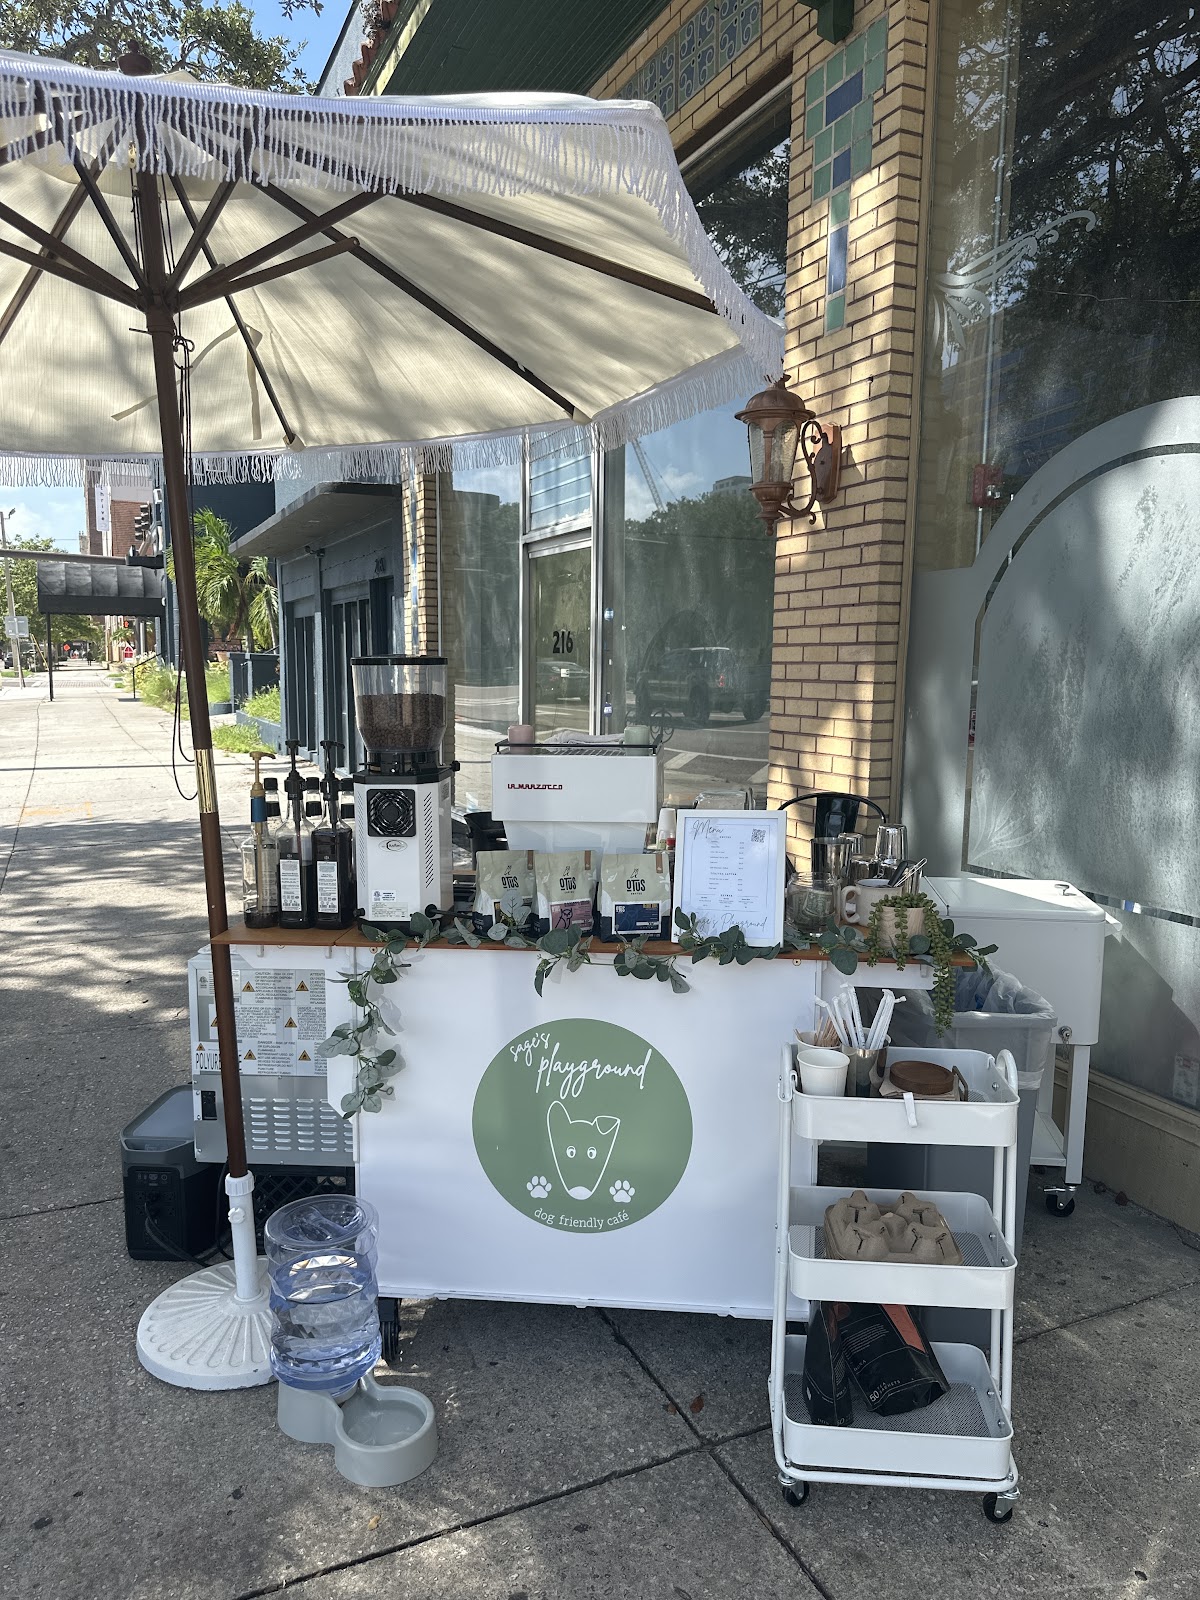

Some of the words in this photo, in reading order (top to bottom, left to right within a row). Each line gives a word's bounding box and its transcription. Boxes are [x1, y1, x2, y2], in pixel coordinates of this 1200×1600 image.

[553, 631, 573, 653] 216
[693, 819, 724, 840] Menu
[501, 876, 519, 889] OTUS
[559, 877, 577, 891] OTUS
[626, 879, 646, 892] OTUS
[509, 1032, 551, 1067] sage's
[535, 1042, 653, 1100] playground
[534, 1207, 556, 1225] dog
[558, 1214, 605, 1230] friendly
[606, 1209, 630, 1227] café
[869, 1390, 880, 1402] 50
